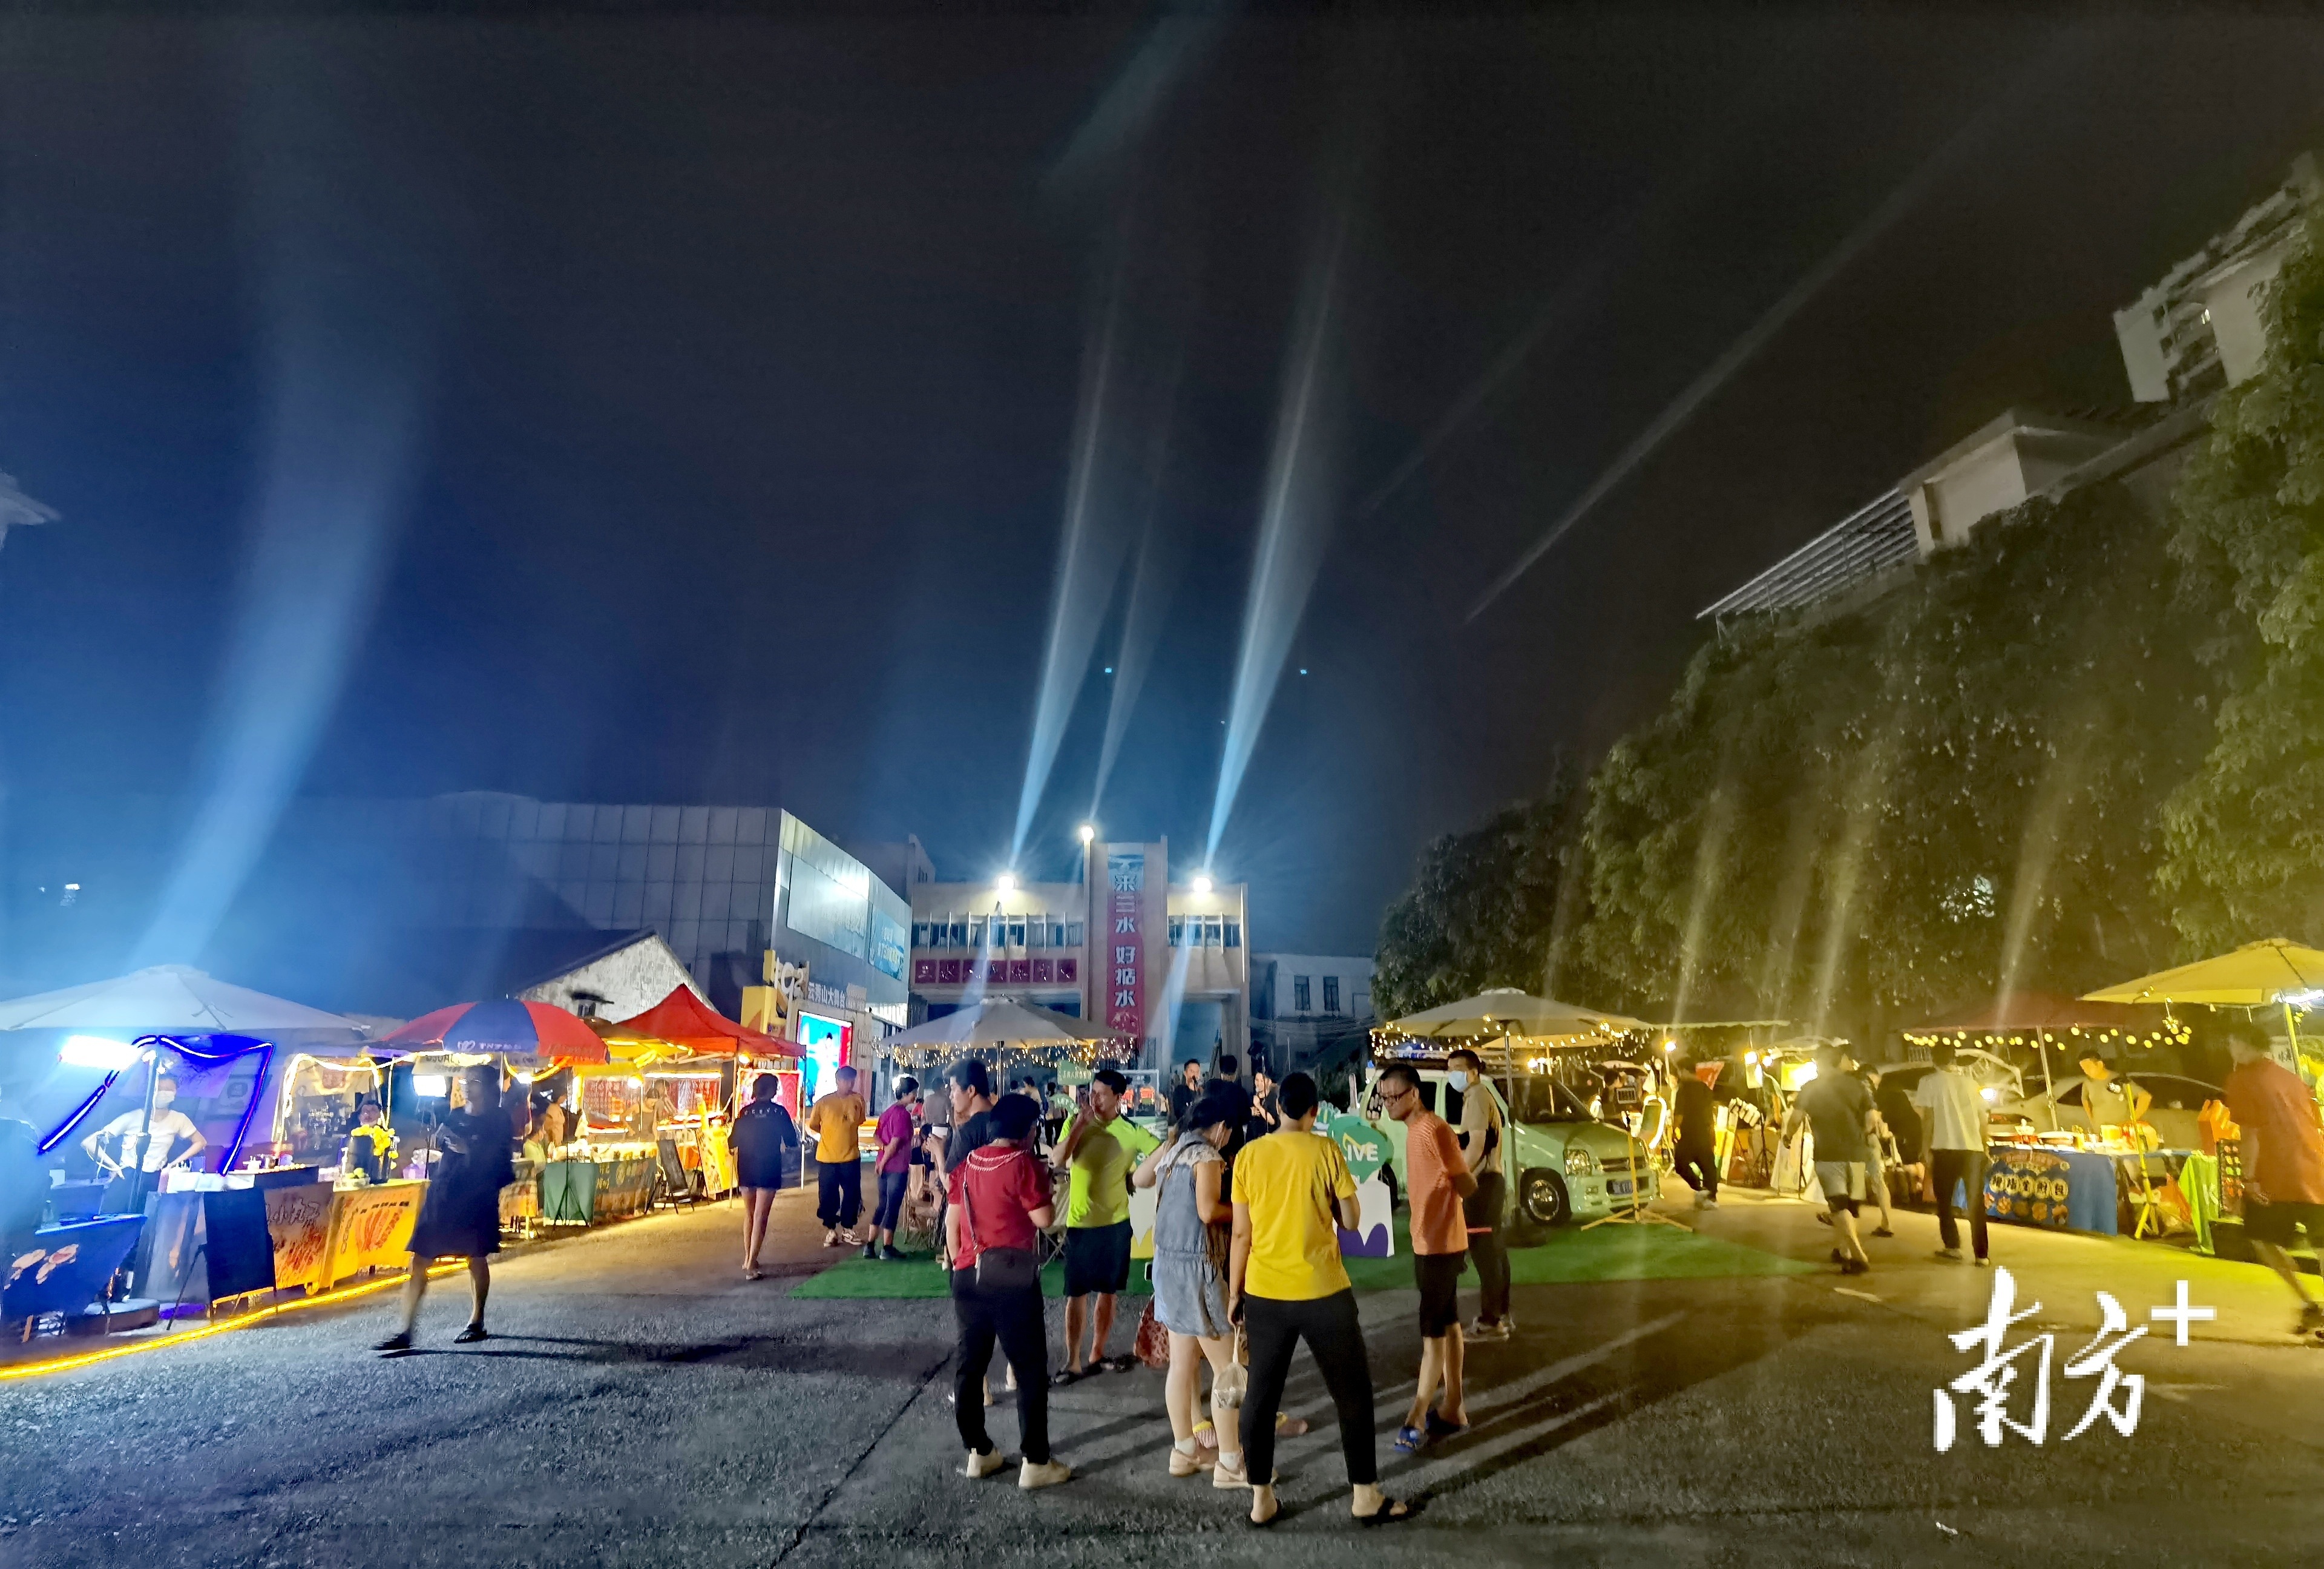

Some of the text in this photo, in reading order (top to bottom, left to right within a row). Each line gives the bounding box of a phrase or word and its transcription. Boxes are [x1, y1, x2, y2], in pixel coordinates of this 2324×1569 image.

[1114, 874, 1136, 933] 来三水
[1346, 1143, 1379, 1162] IVE
